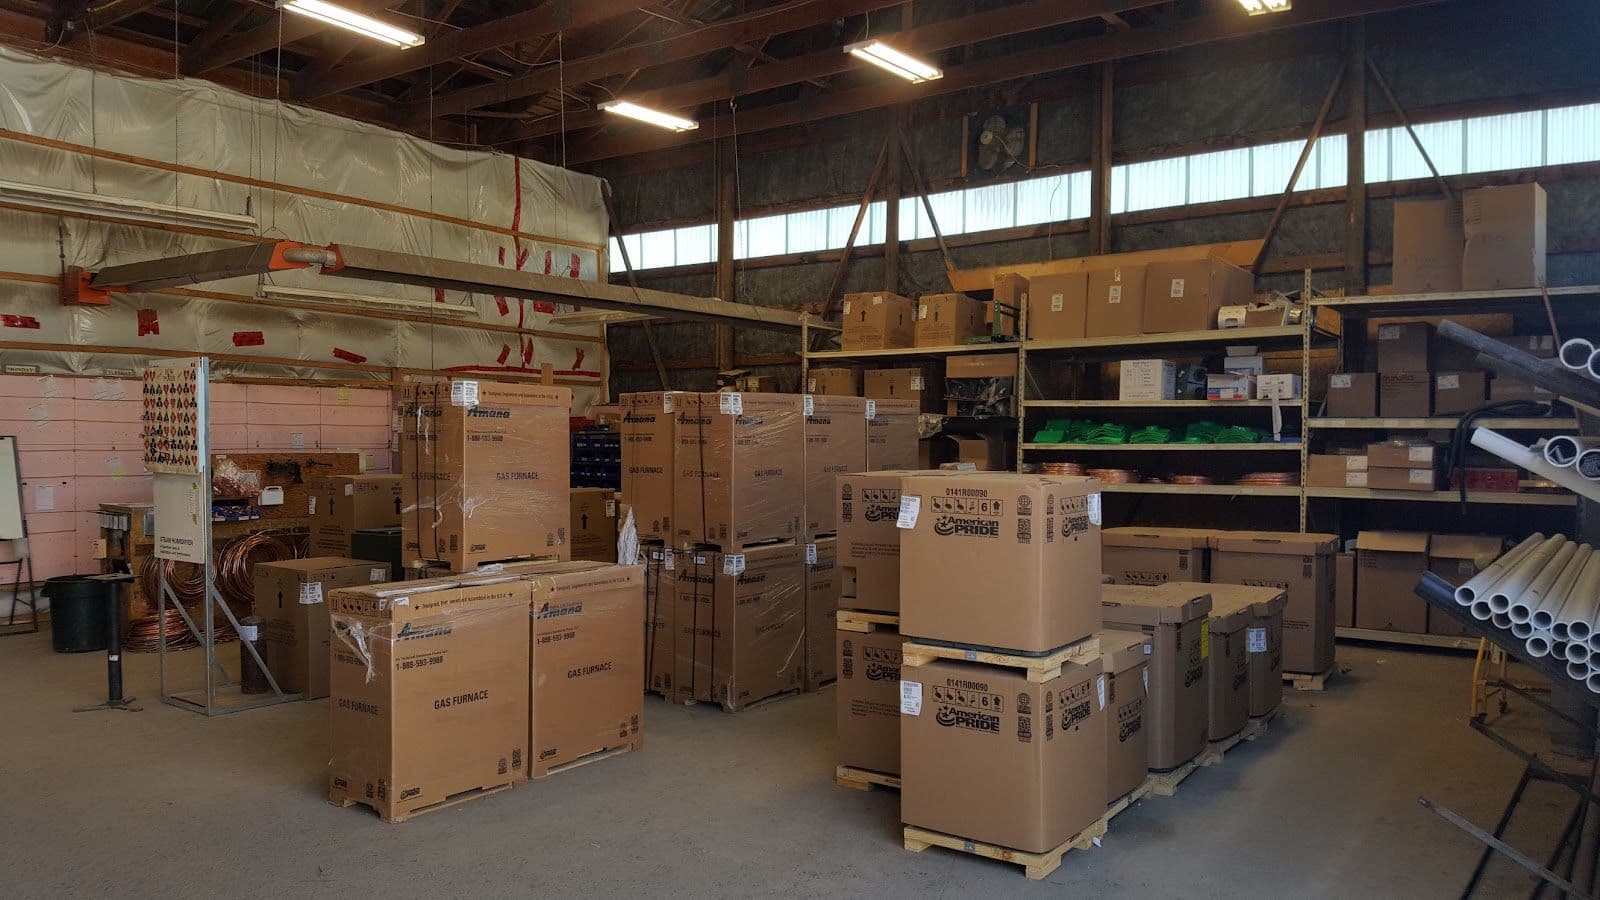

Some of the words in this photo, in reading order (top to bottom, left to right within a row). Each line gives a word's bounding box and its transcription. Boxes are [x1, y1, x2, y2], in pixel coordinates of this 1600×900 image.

[466, 404, 511, 420] Amana
[623, 410, 656, 424] Amana
[677, 411, 712, 425] Amana
[496, 472, 509, 481] GAS
[511, 471, 539, 480] FURNACE
[981, 502, 988, 512] 6
[881, 511, 900, 520] PRI
[947, 516, 999, 527] American
[954, 524, 999, 536] PRIDE
[536, 601, 583, 620] Amana
[567, 669, 582, 679] GAS
[583, 661, 613, 676] FURNACE
[882, 671, 901, 681] PRI
[434, 697, 452, 710] GAS
[452, 689, 489, 705] FURNACE
[981, 696, 989, 707] 6
[338, 698, 351, 709] GAS
[351, 701, 379, 716] FURNACE
[948, 707, 1000, 723] American
[955, 716, 1000, 732] PRIDE
